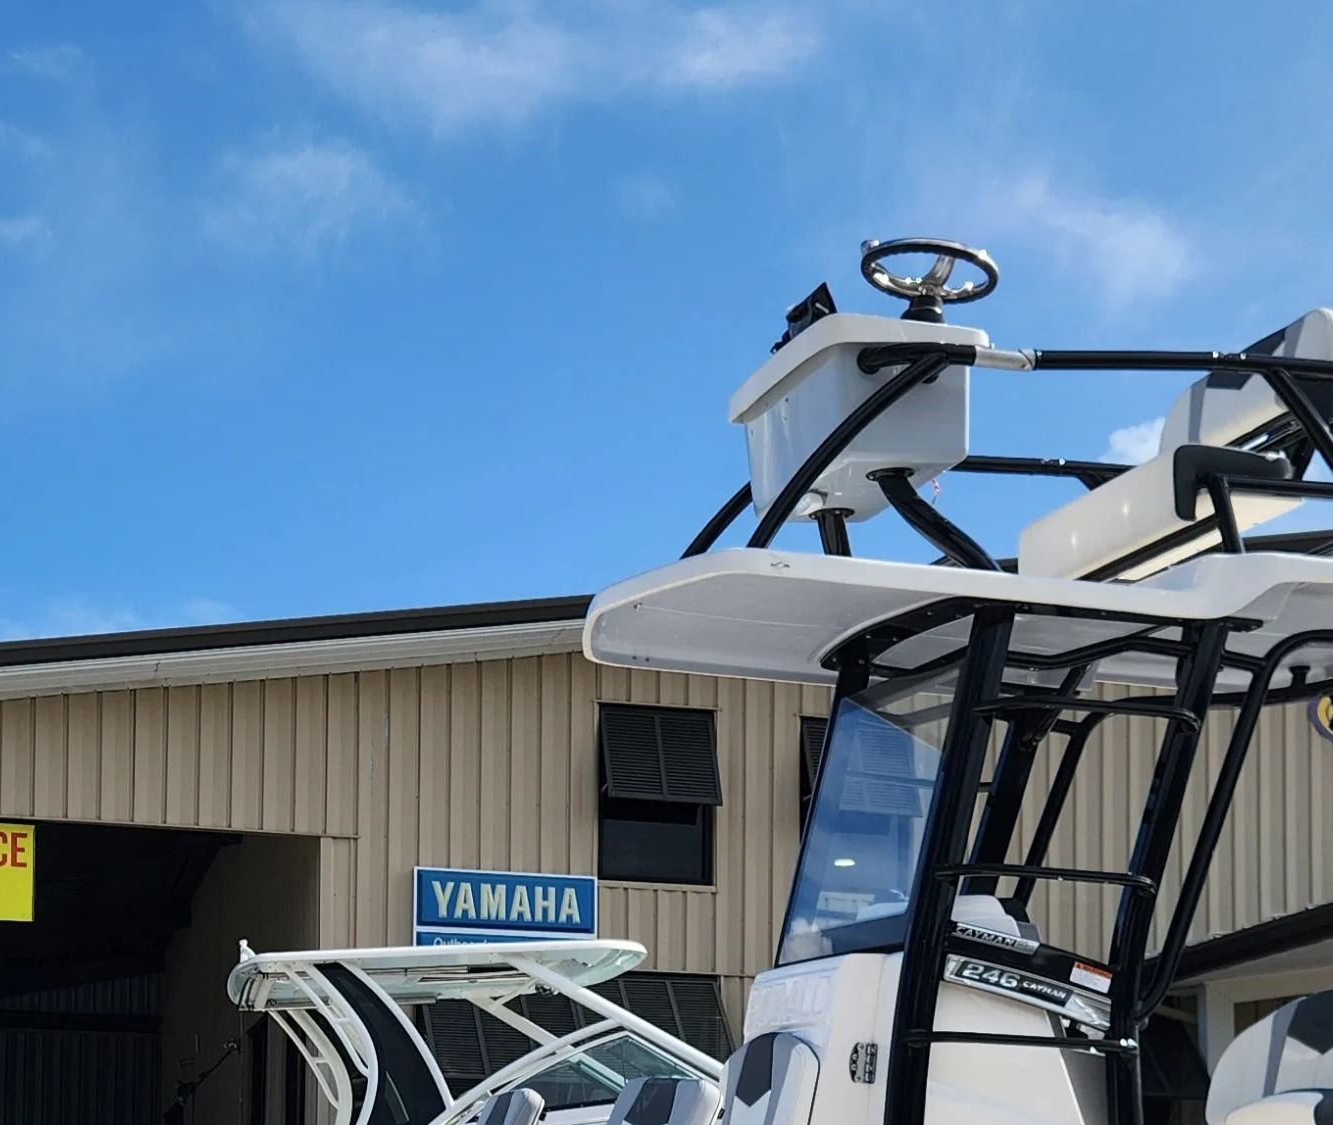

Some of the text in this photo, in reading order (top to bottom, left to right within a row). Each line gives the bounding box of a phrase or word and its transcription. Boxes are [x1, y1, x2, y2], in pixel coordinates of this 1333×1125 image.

[431, 880, 581, 925] YAMAHA
[955, 926, 1017, 948] CAYMAN
[961, 963, 1067, 999] 246 CAYMAN
